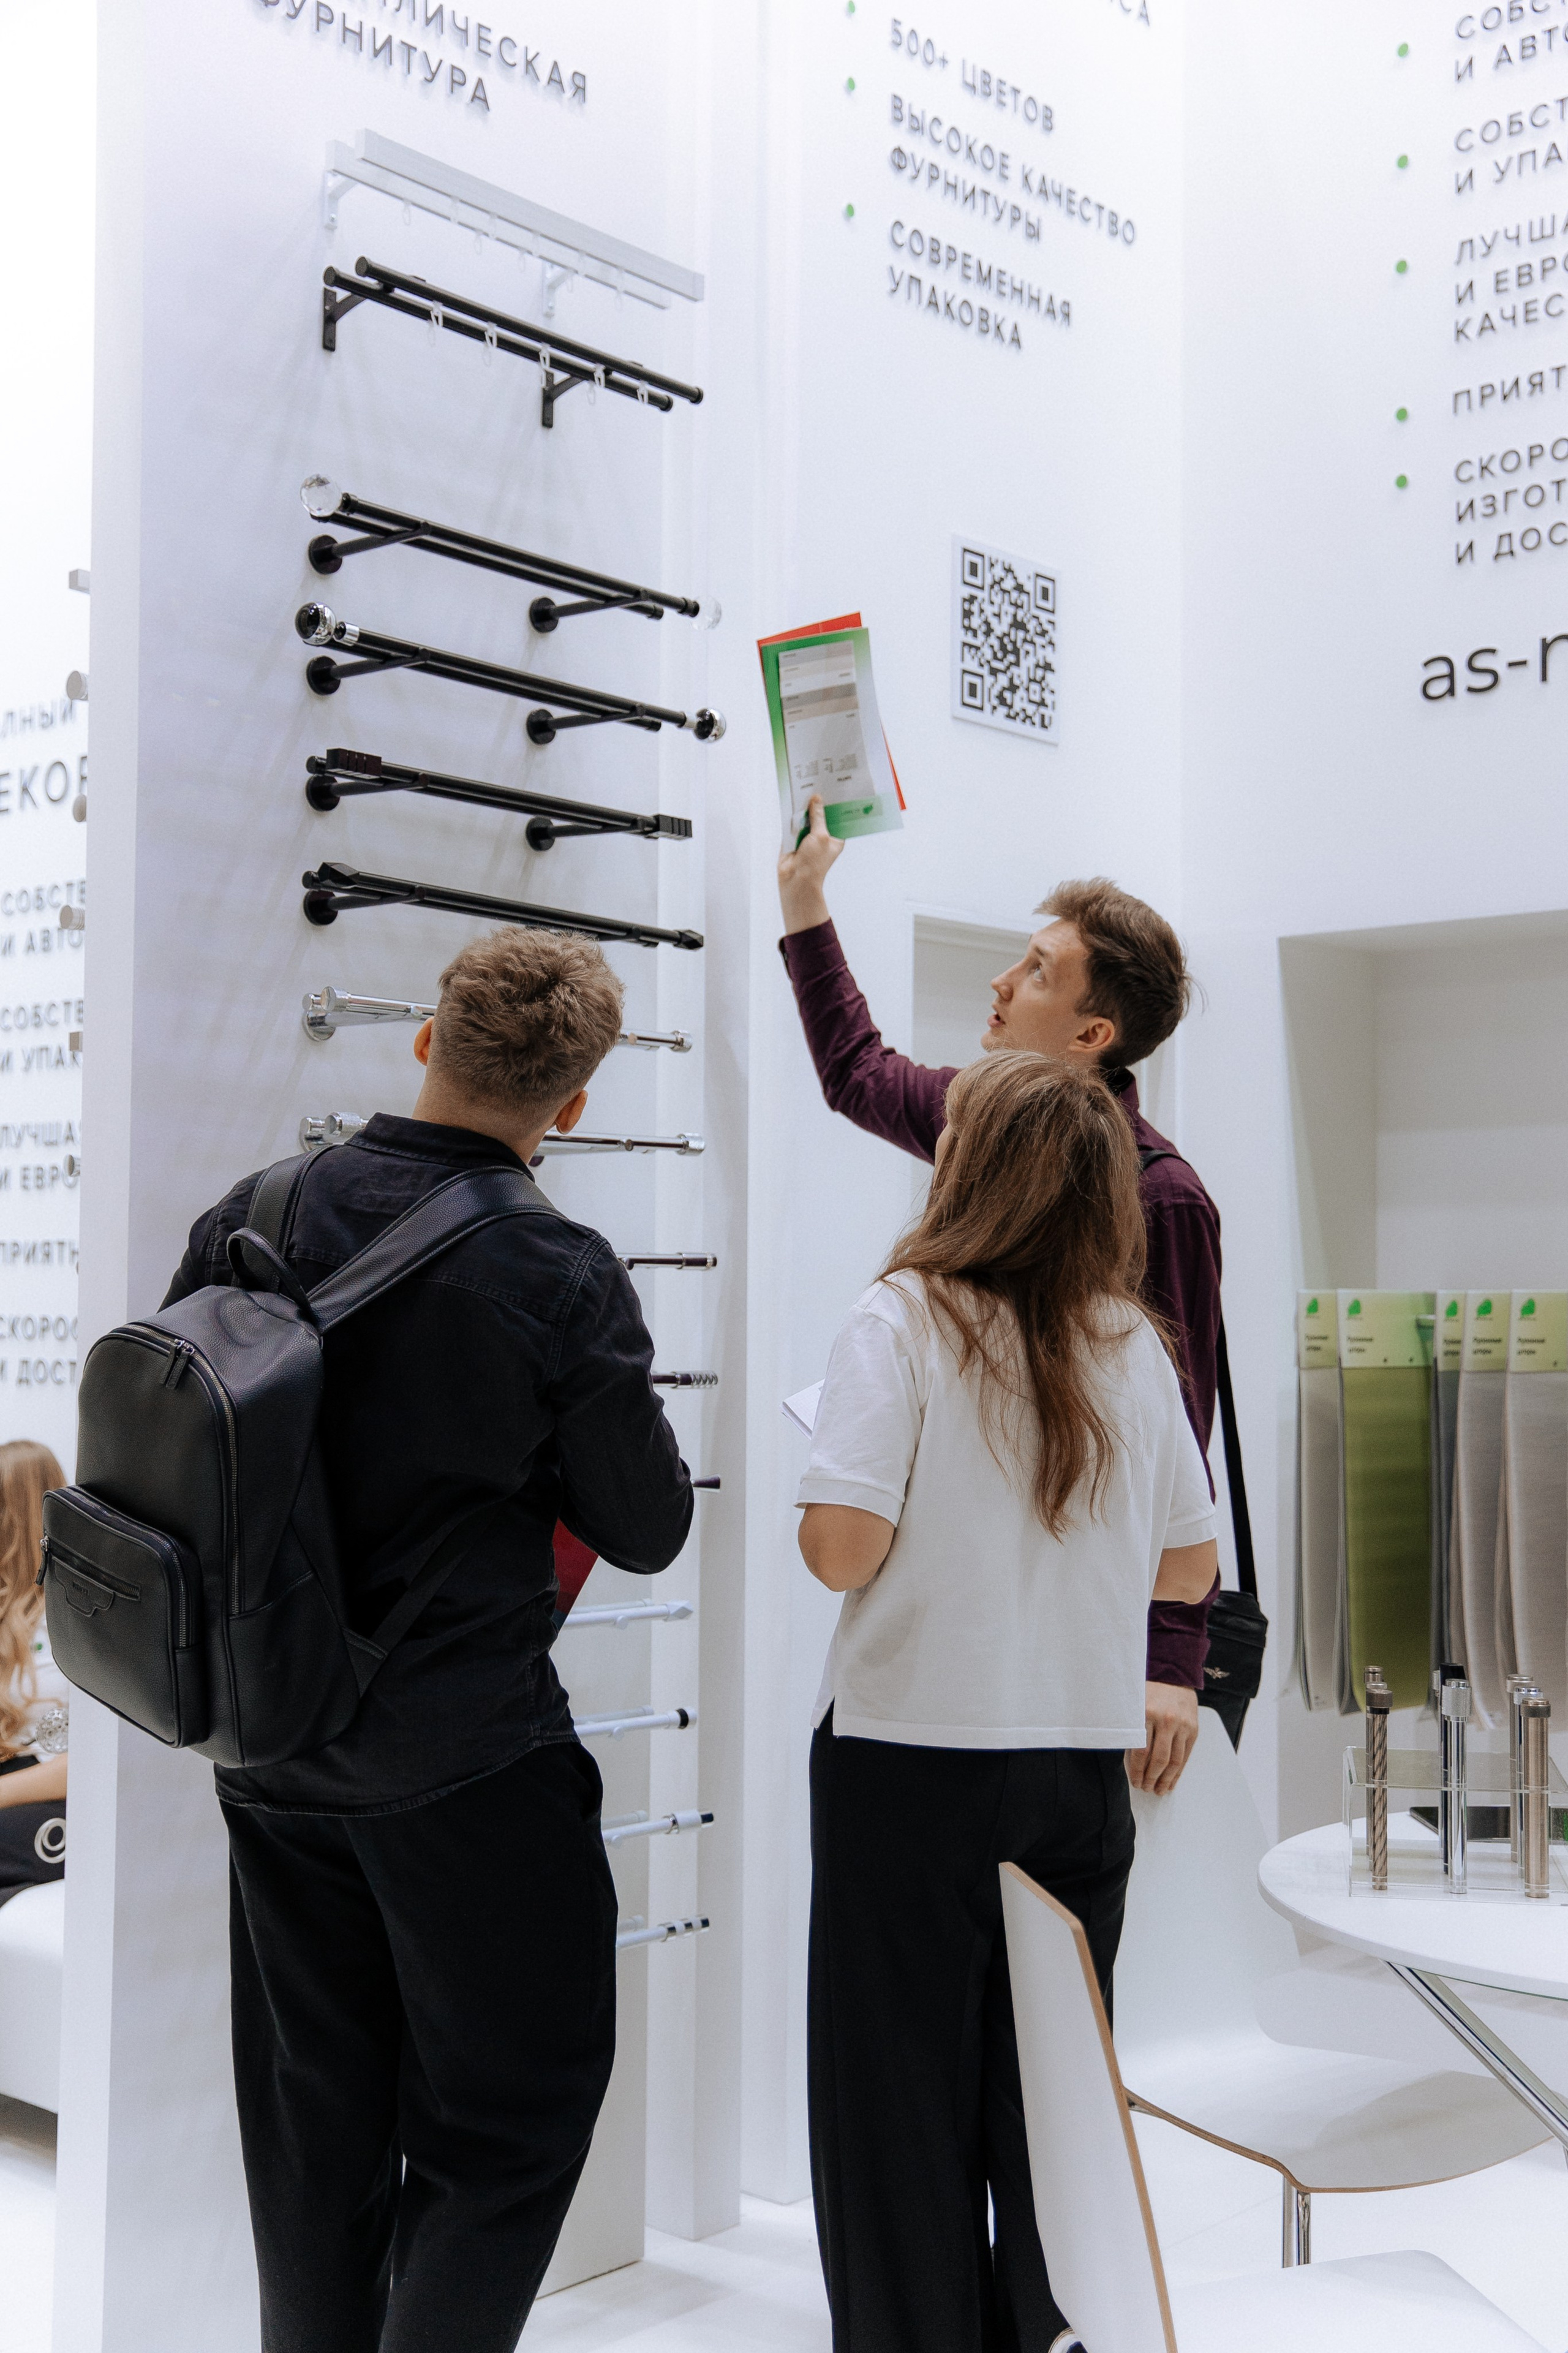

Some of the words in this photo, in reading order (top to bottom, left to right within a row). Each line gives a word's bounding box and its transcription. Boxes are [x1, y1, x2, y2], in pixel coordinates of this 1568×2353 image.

[1455, 0, 1566, 39] СОБС
[261, 0, 489, 111] УРНИТУРА
[891, 18, 948, 70] 500+
[961, 58, 1053, 132] ЦВЕТОВ
[1455, 55, 1473, 83] И
[1493, 23, 1568, 71] АВТ
[891, 93, 1009, 180] ВЫСОКОЕ
[1022, 163, 1136, 244] КАЧЕСТВО
[891, 146, 1040, 243] ФУРНИТУРЫ
[1455, 169, 1473, 195] И
[891, 220, 1070, 327] СОВРЕМЕННАЯ
[1455, 279, 1473, 304] И
[1494, 252, 1568, 294] ЕВР
[889, 265, 1022, 350] УПАКОВКА
[1454, 293, 1564, 342] КАЧЕС
[1453, 364, 1566, 415] ПРИЯТ
[1456, 478, 1566, 523] ИЗГОТ
[1455, 539, 1473, 565] И
[1493, 521, 1568, 562] ДОС
